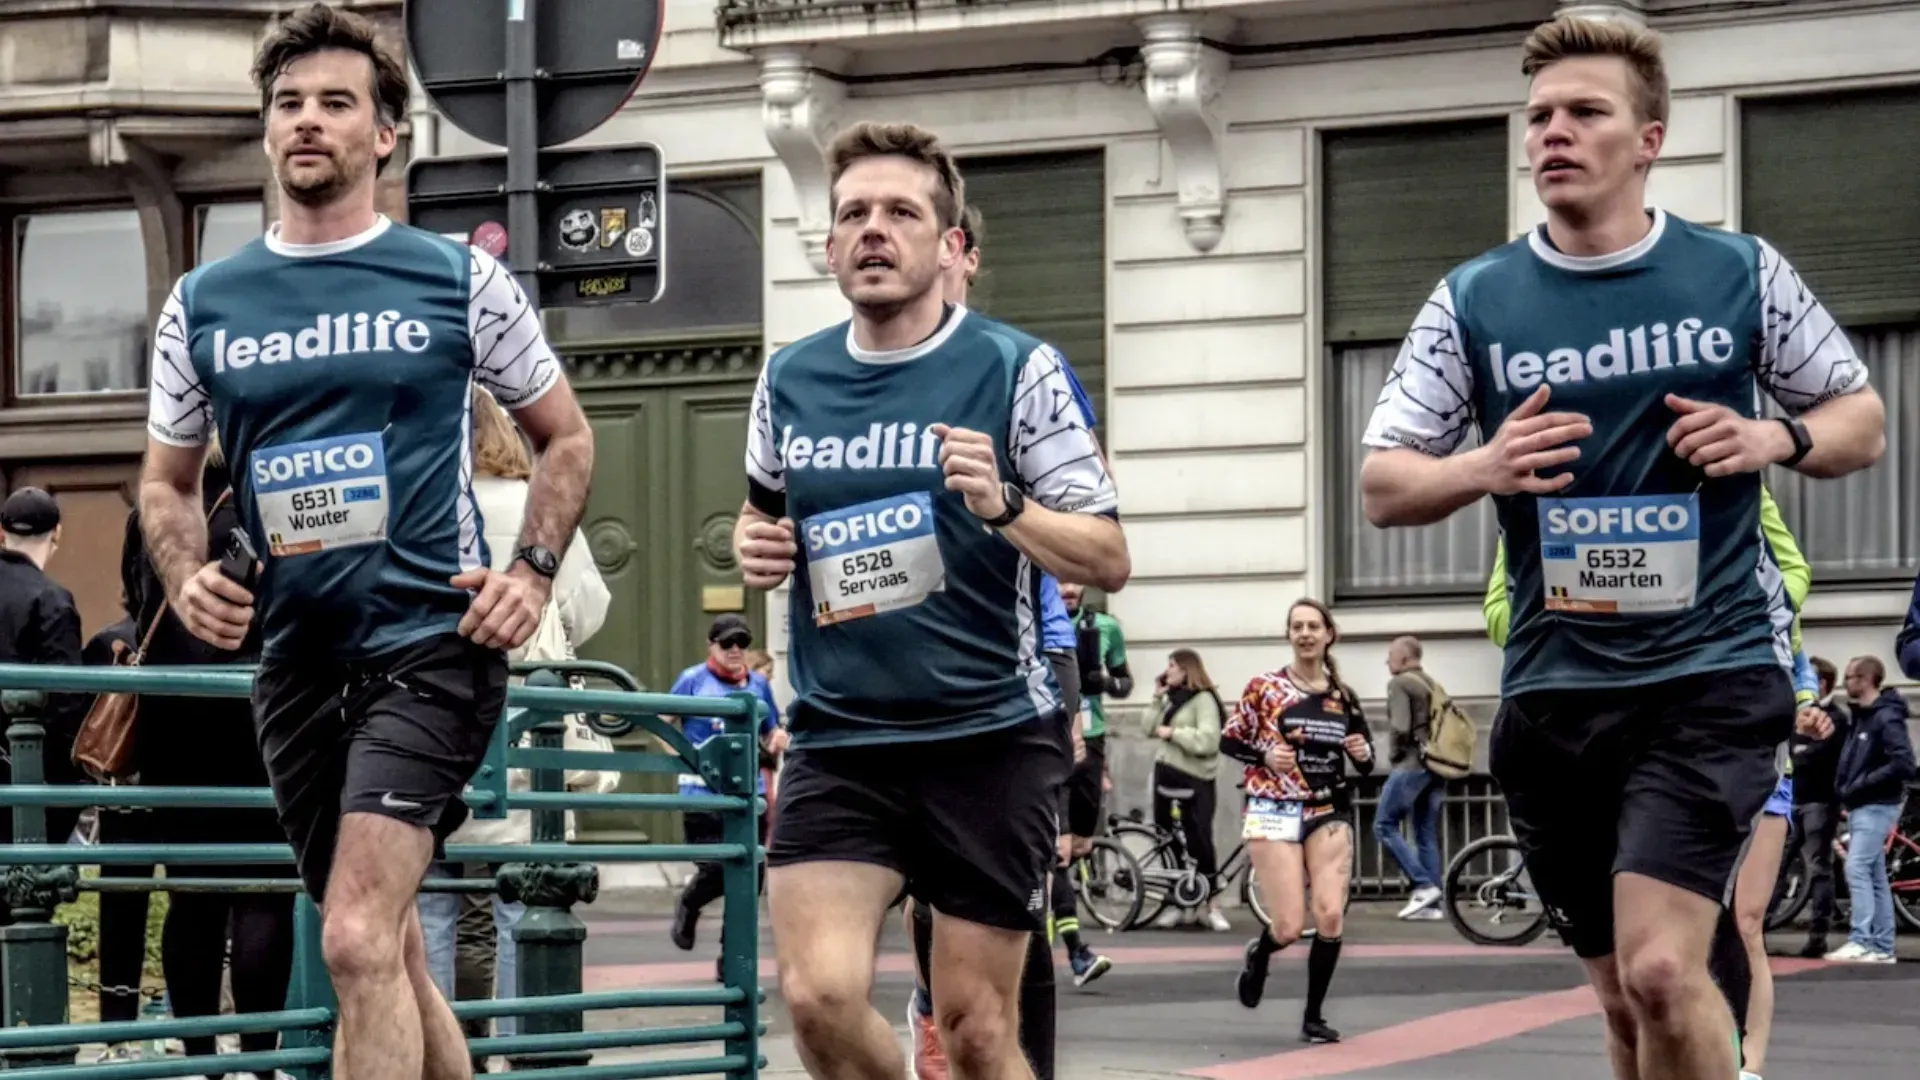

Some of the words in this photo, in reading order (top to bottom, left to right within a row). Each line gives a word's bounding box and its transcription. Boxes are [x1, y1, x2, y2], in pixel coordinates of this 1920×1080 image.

[213, 309, 431, 374] leadlife
[1488, 317, 1734, 393] leadlife
[780, 421, 945, 470] leadlif
[254, 443, 374, 485] SOFICO
[291, 486, 337, 512] 6531
[288, 508, 351, 532] Wouter
[808, 503, 922, 552] SOFICO
[1547, 504, 1690, 535] SOFICO
[842, 549, 894, 577] 6528
[1586, 548, 1647, 569] 6532
[838, 570, 909, 597] Servaas
[1578, 570, 1663, 588] Maarten
